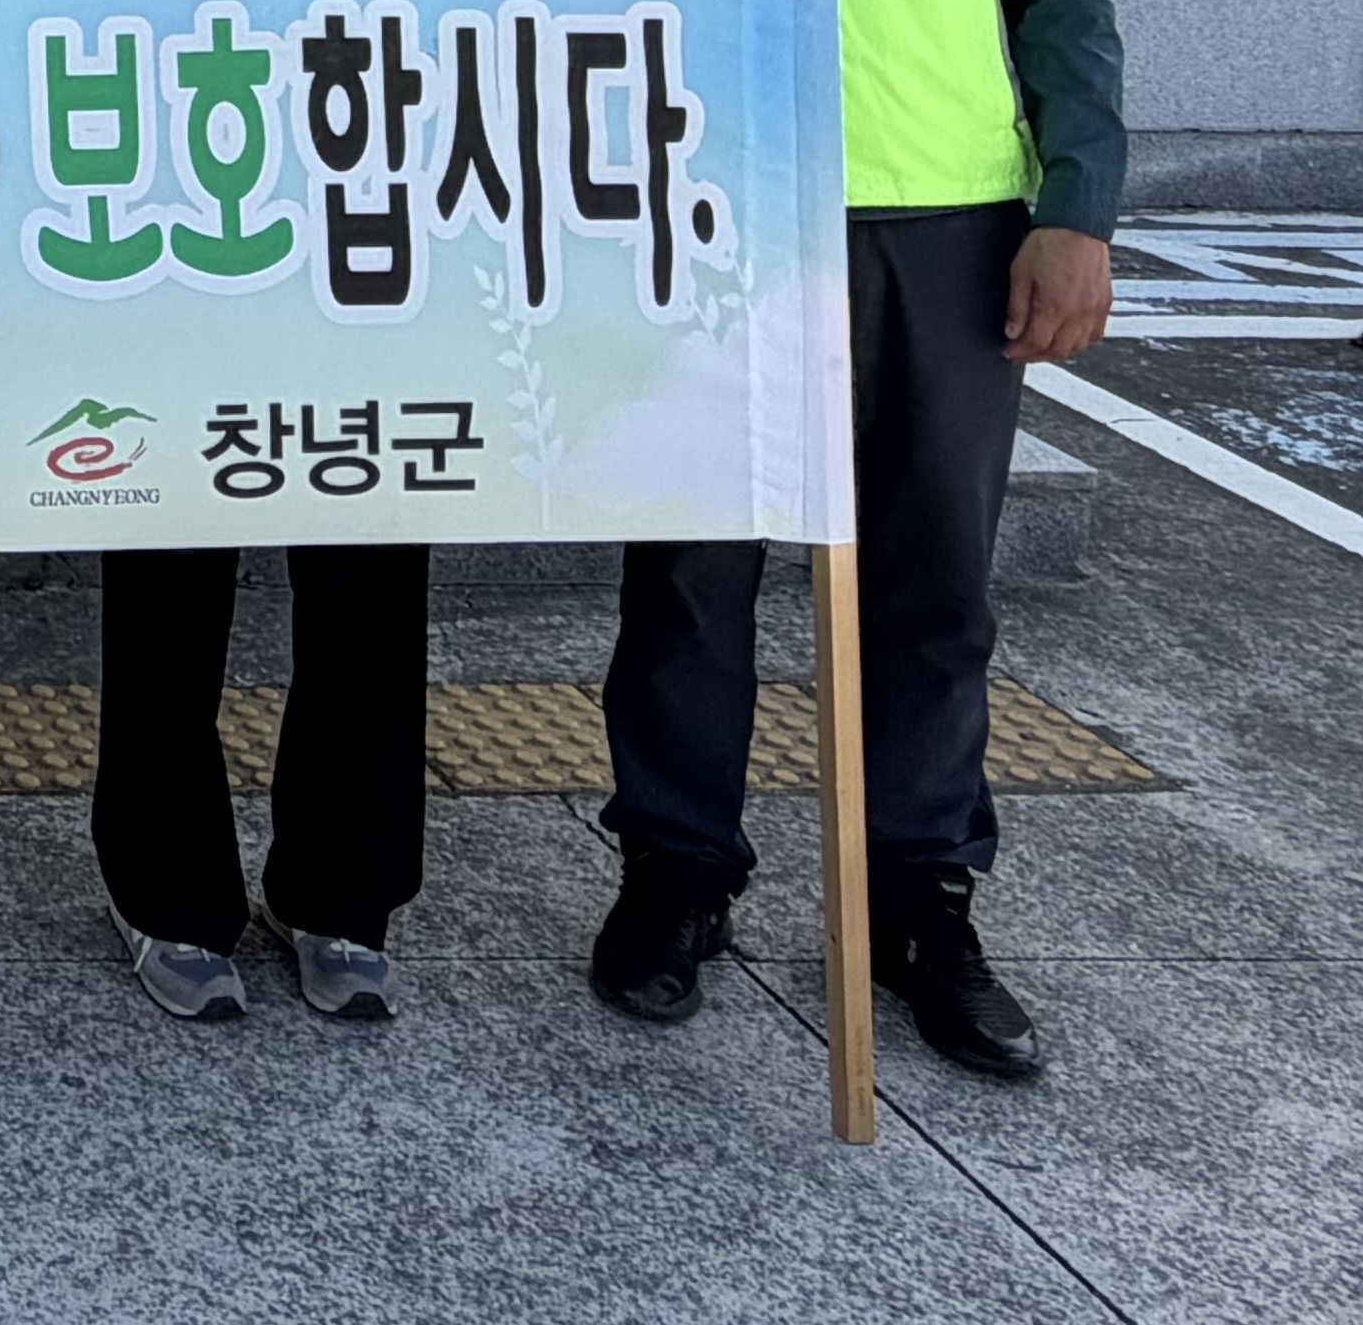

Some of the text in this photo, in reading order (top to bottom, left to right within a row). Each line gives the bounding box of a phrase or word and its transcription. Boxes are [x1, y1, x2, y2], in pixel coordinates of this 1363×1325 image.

[36, 16, 715, 308] 보호합시다.
[29, 488, 161, 507] CHANGNYEONG
[199, 400, 484, 500] 창녕군
